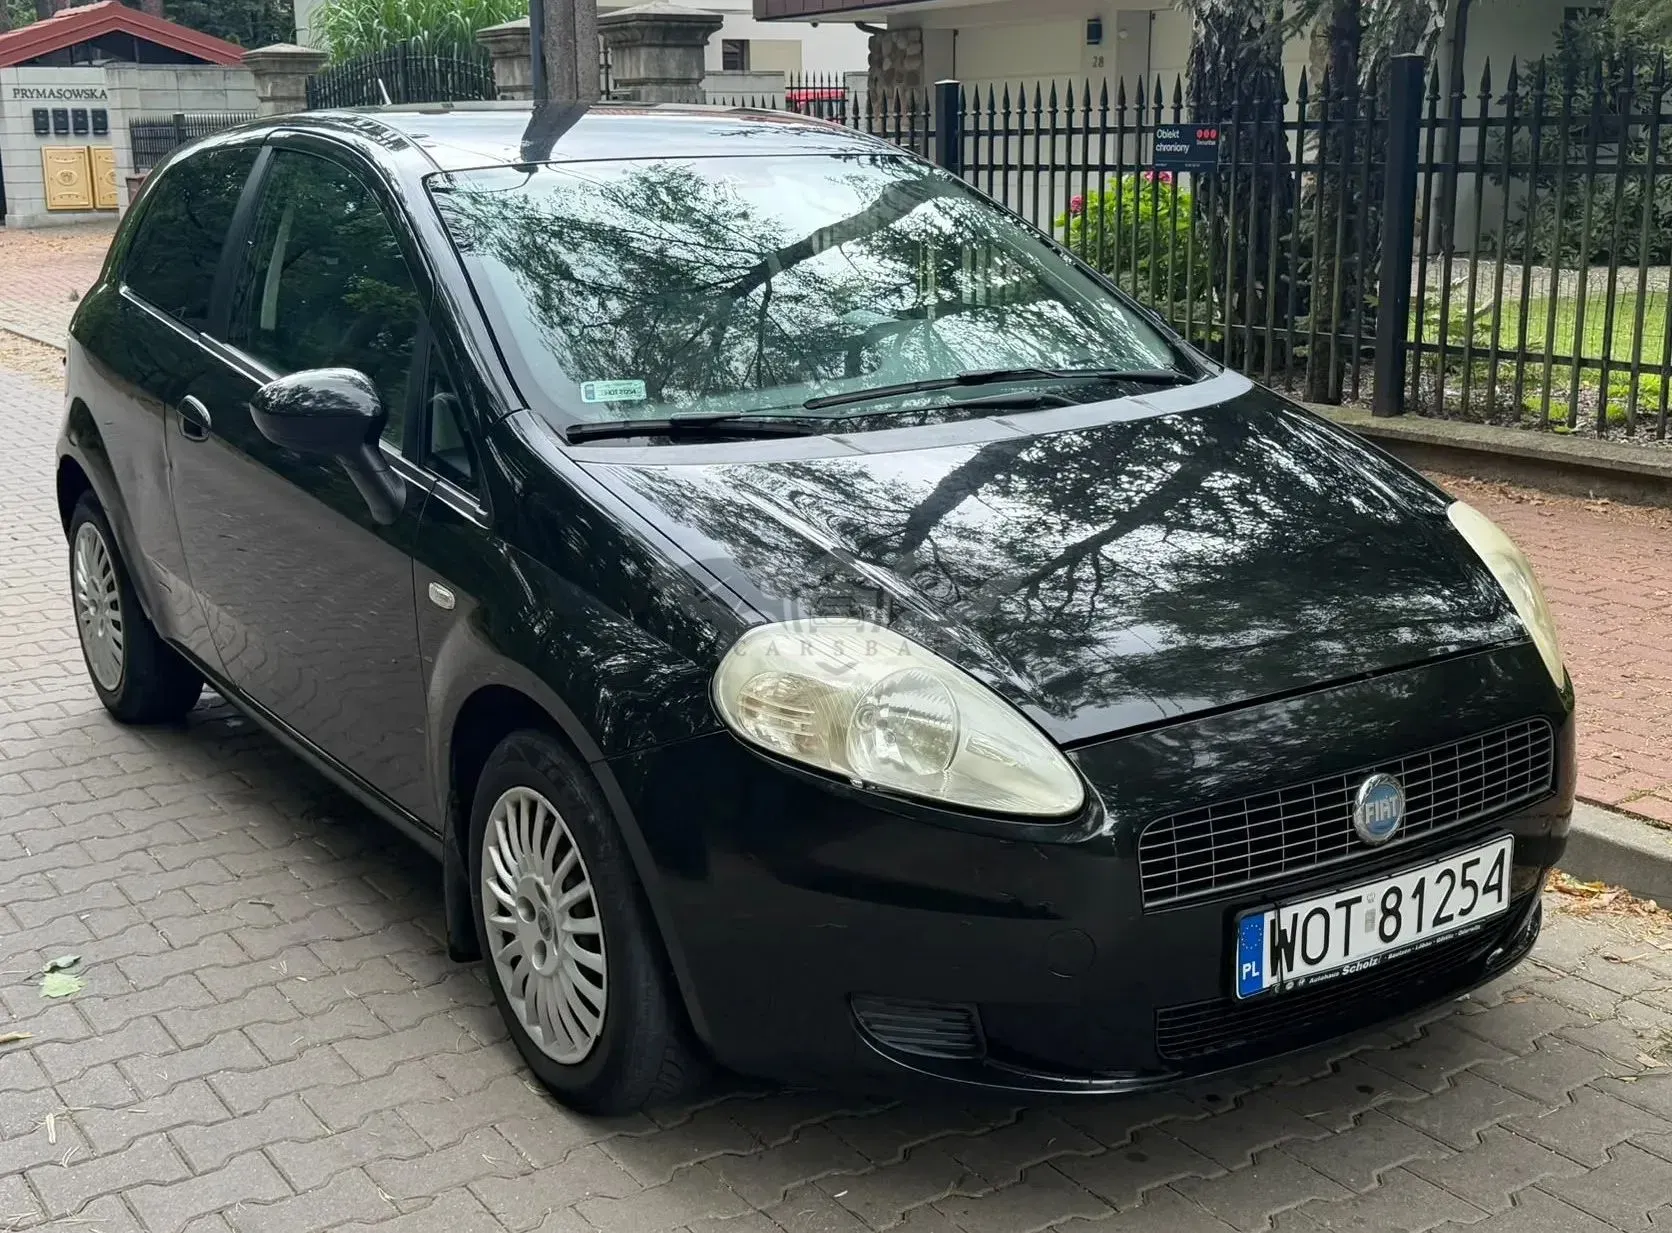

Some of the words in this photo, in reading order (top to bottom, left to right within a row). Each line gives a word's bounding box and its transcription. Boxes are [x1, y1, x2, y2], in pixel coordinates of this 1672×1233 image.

[1092, 55, 1104, 68] 28
[12, 88, 108, 100] PRYMASOWSKA
[1156, 128, 1180, 139] Obiekt
[1155, 142, 1190, 154] chroniony
[1365, 795, 1399, 825] FIAT
[1269, 895, 1363, 979] WOT
[1378, 847, 1506, 944] 81254
[1242, 961, 1260, 981] PL
